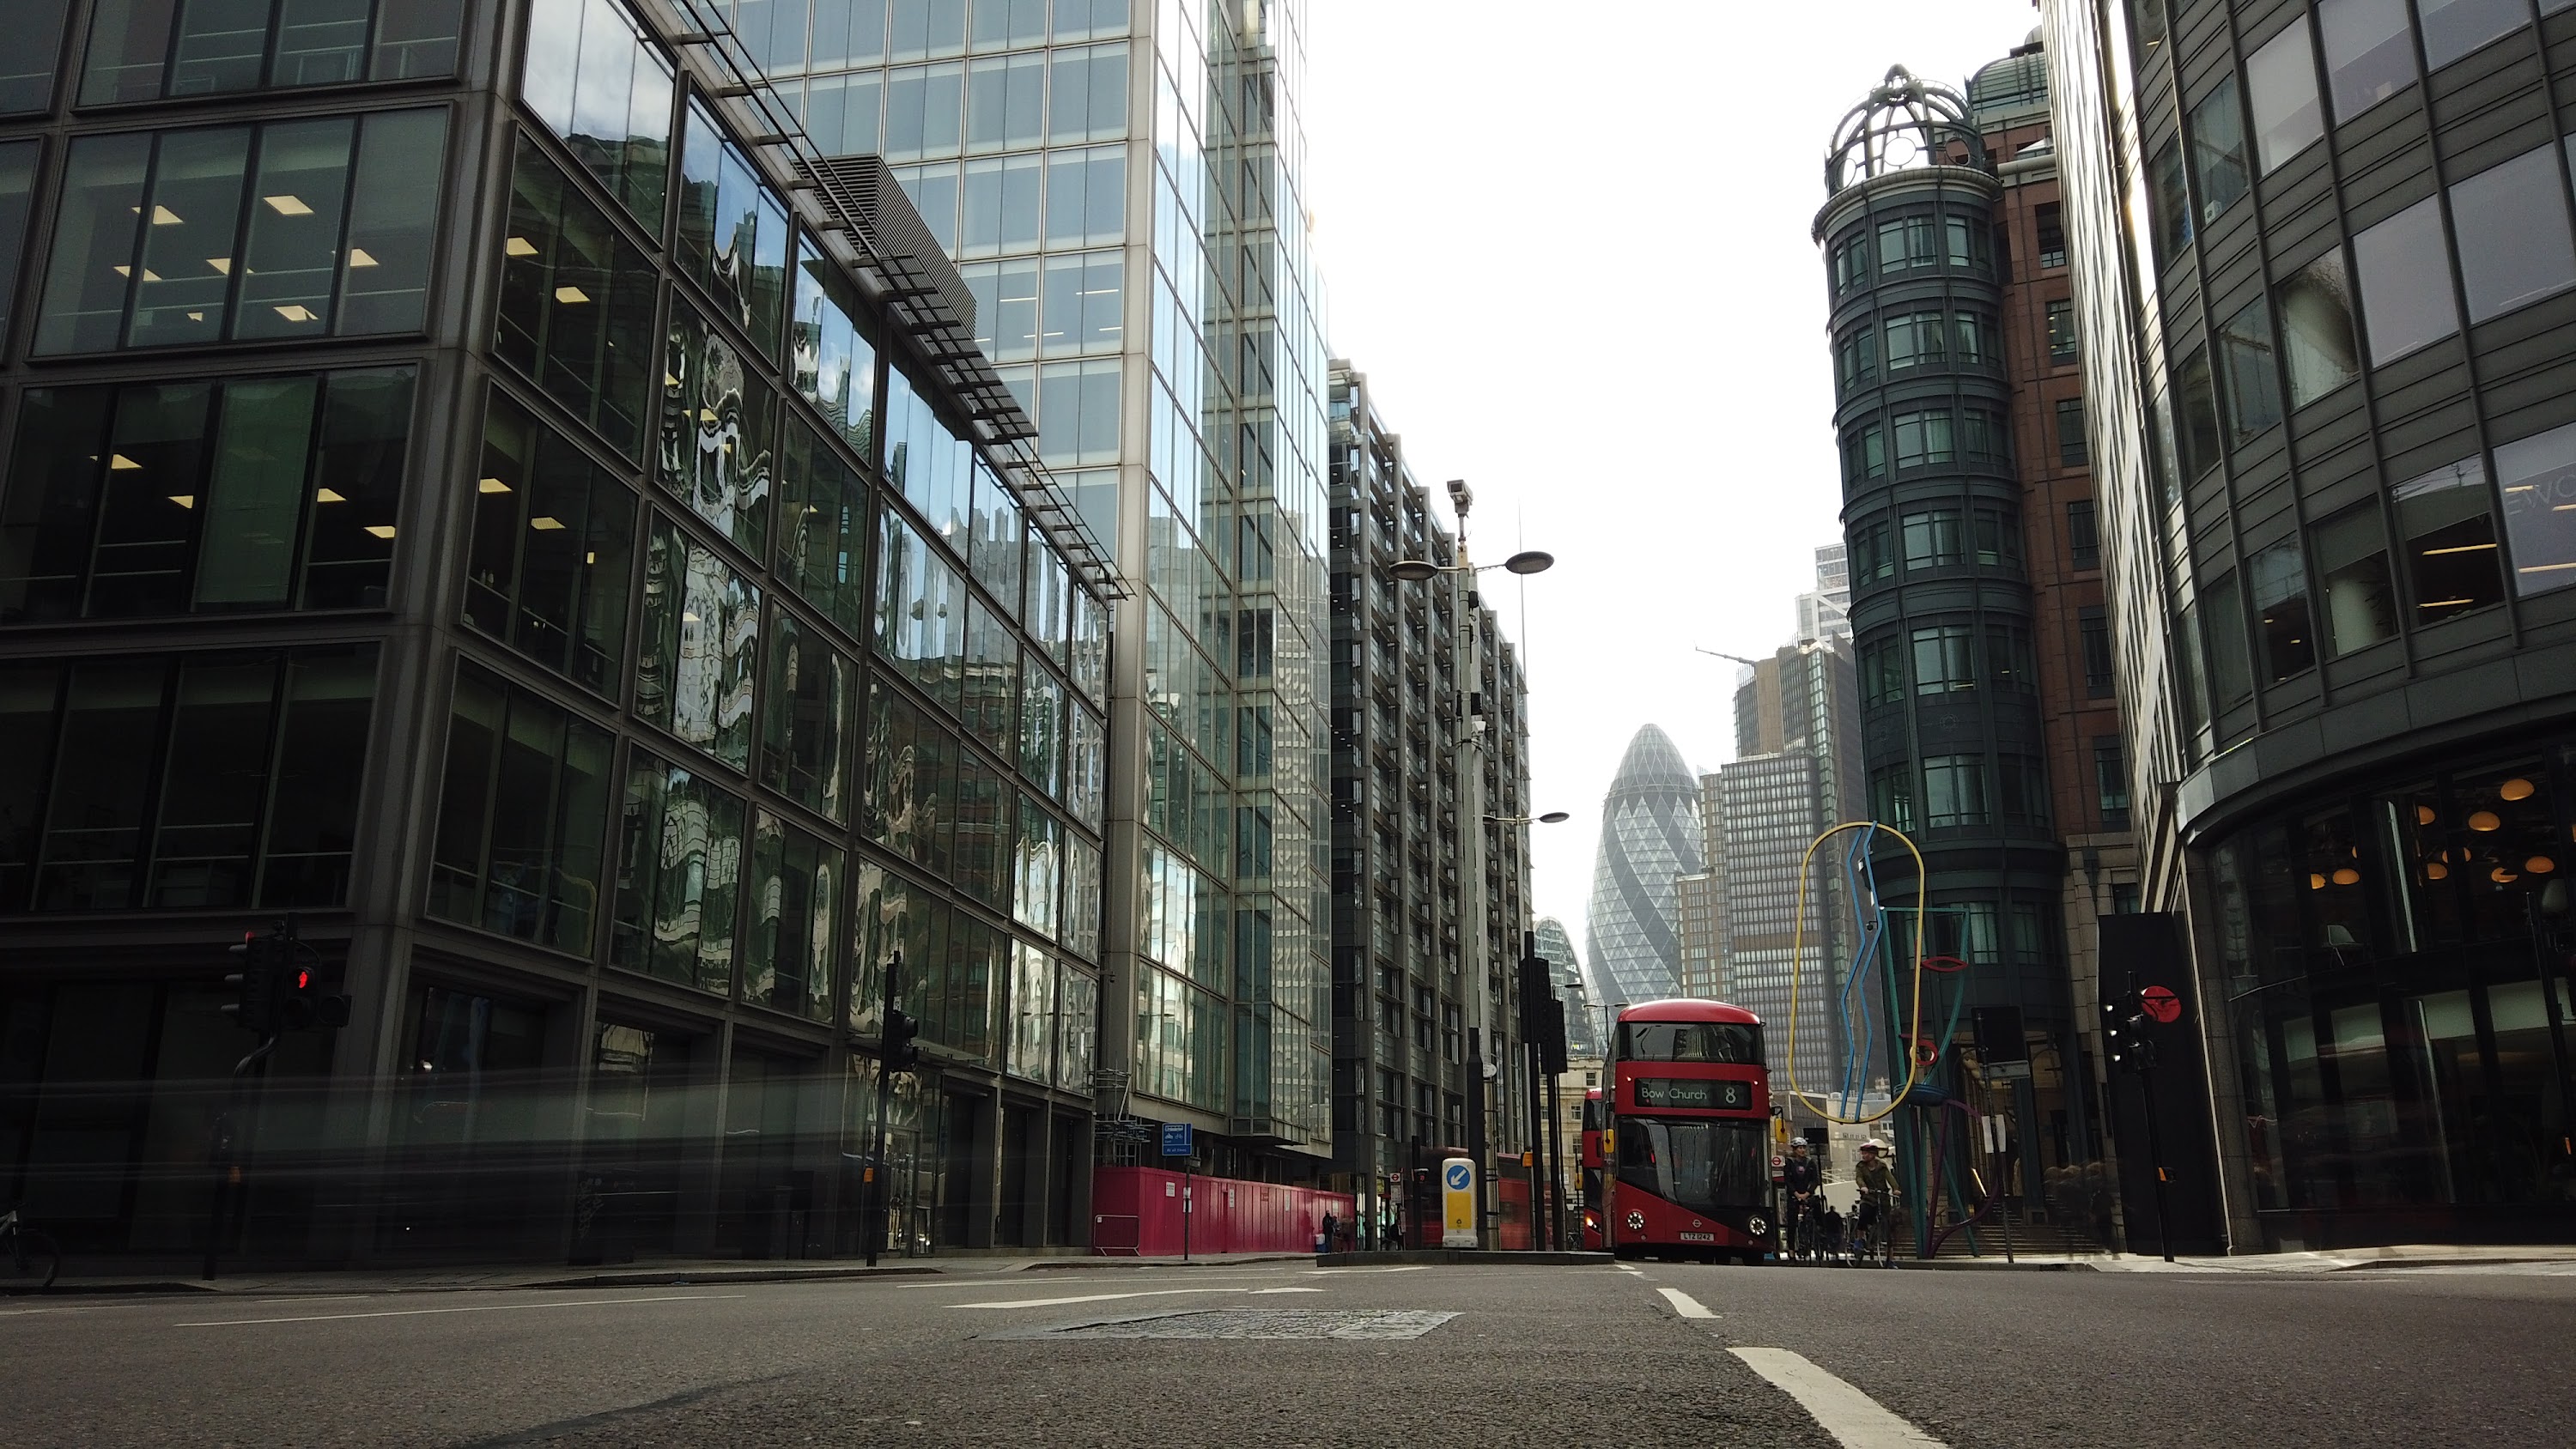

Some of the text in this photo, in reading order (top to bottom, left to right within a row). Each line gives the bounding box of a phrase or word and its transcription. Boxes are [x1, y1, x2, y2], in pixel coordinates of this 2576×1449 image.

[1641, 1087, 1707, 1100] Bow Church
[1725, 1086, 1736, 1104] 8
